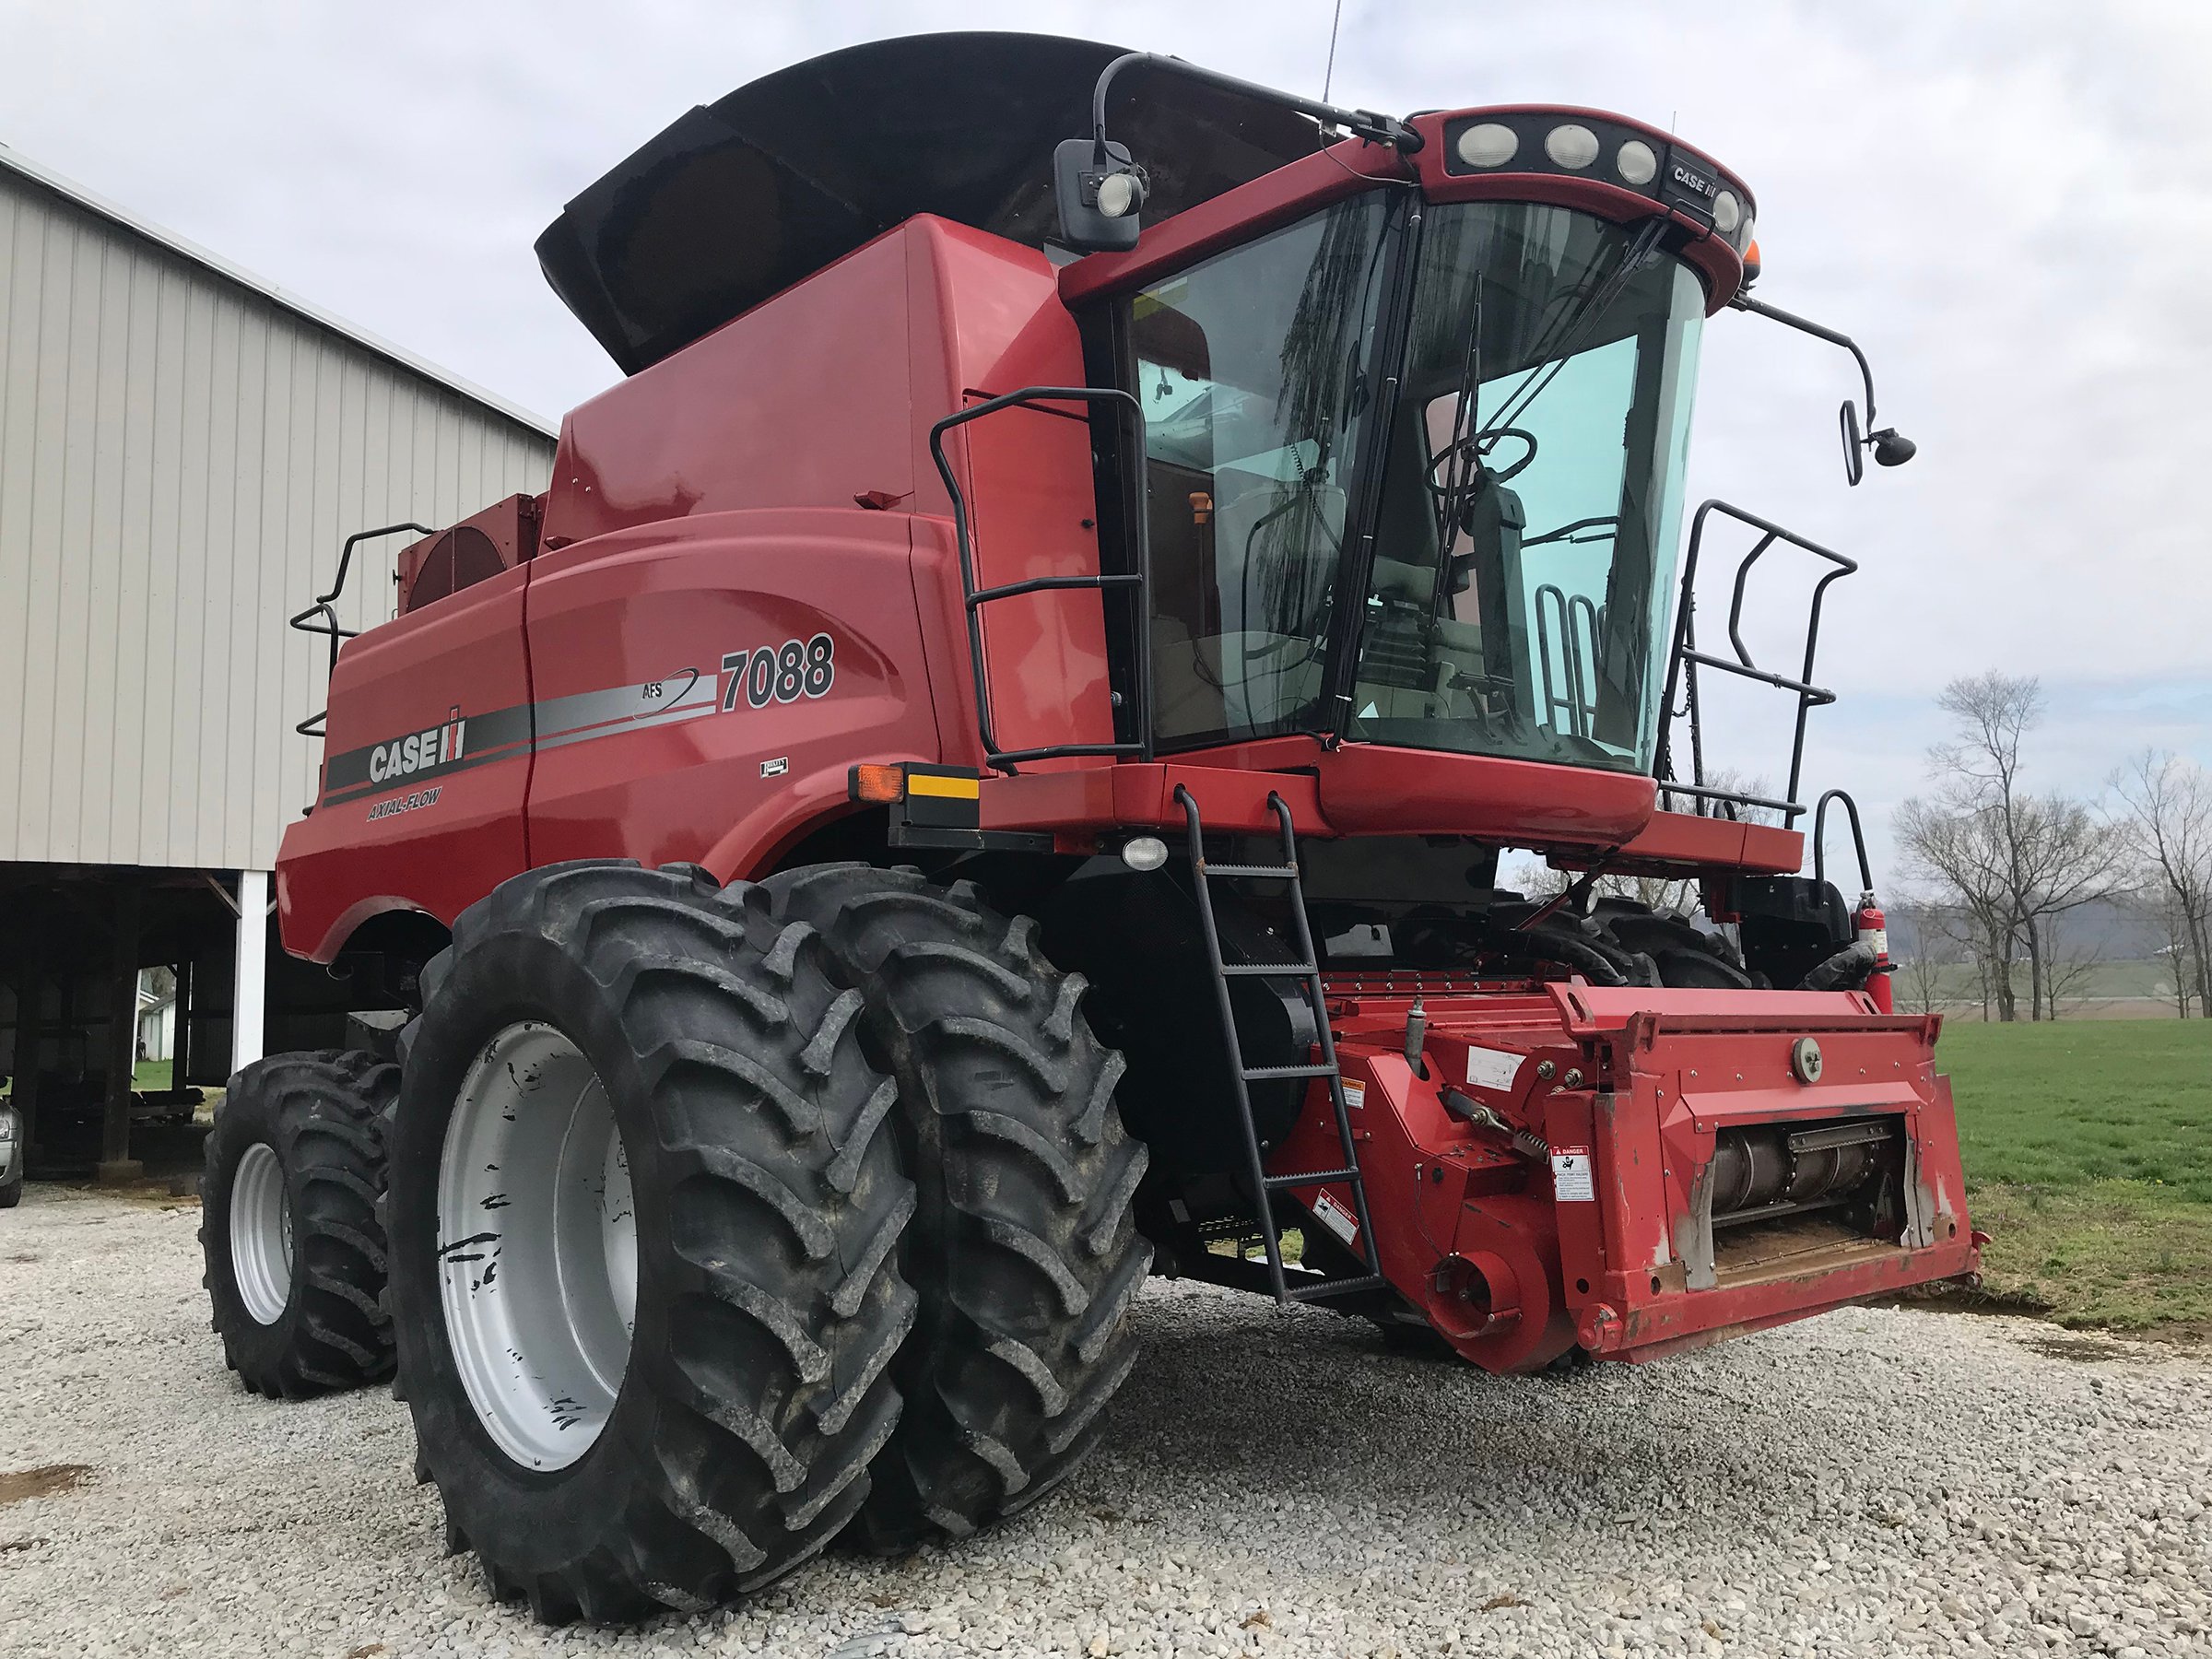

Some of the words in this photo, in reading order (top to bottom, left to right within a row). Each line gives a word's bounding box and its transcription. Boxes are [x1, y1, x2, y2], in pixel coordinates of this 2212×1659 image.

[1674, 167, 1704, 192] CASE
[721, 632, 835, 713] 7088
[641, 682, 663, 699] AFS
[370, 729, 439, 783] CASE
[367, 786, 442, 822] AXIAL-FLOW
[1333, 1201, 1352, 1220] DANGER
